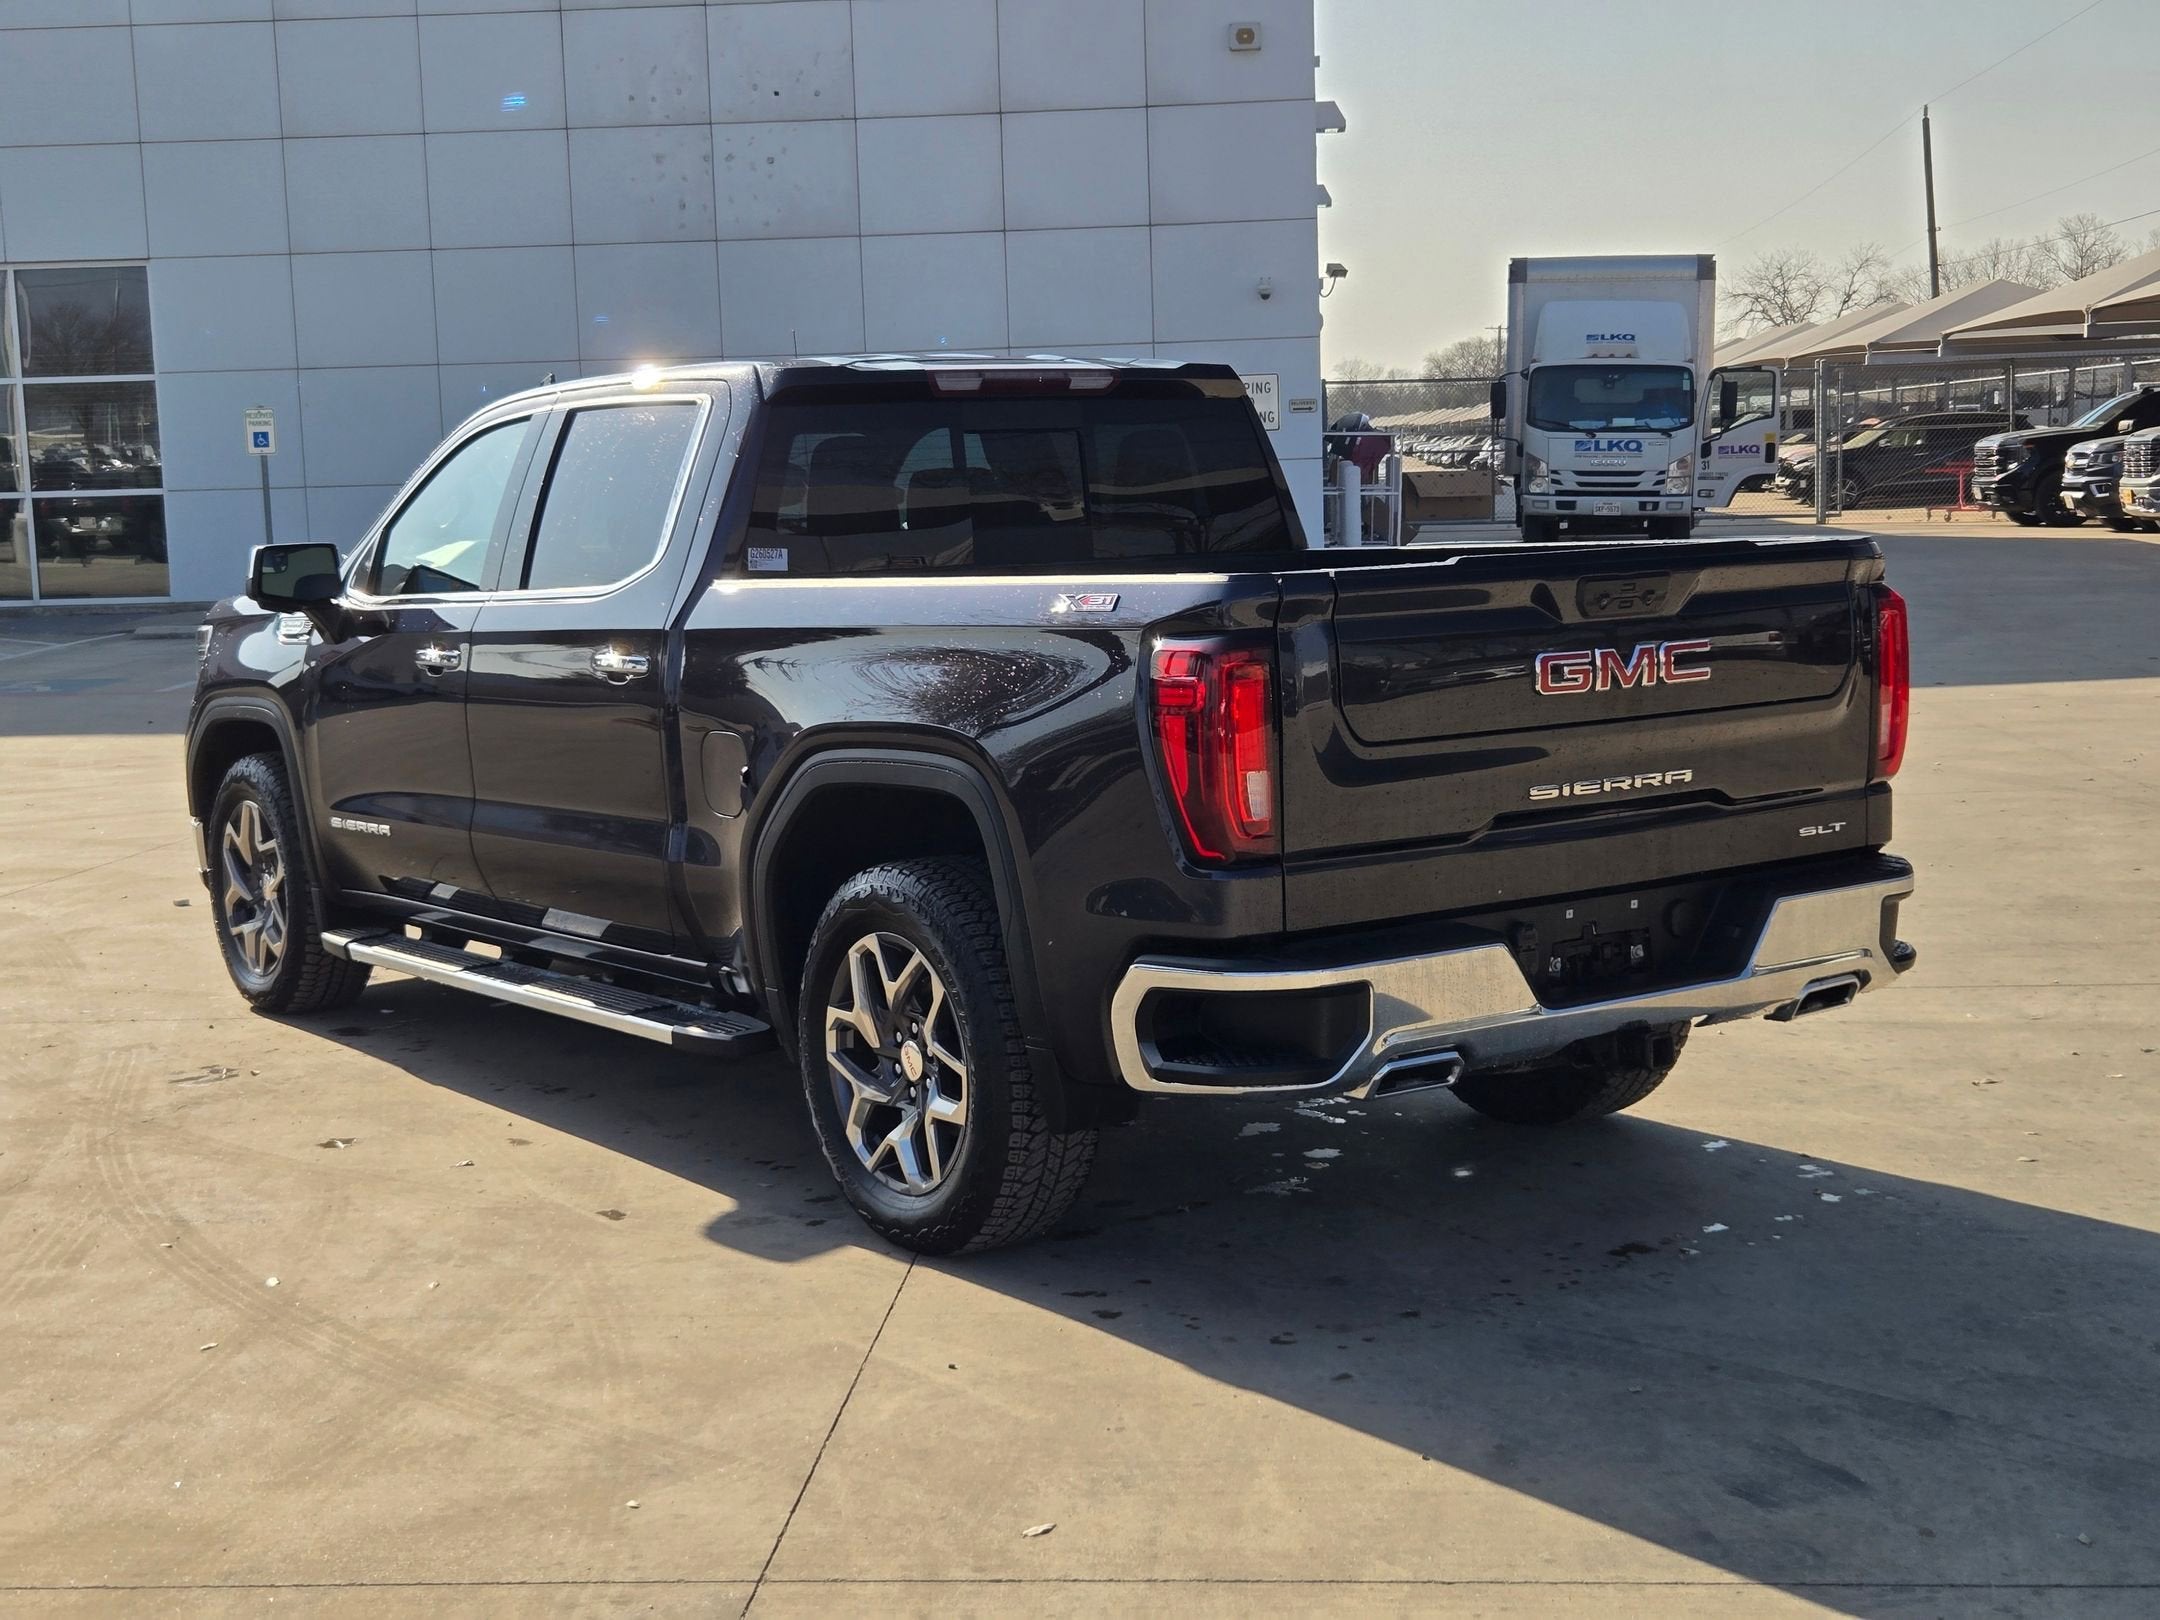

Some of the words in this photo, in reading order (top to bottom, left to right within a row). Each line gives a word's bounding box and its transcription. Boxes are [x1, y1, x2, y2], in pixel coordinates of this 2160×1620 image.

[1594, 440, 1643, 452] LKQ
[1731, 445, 1760, 454] LKQ
[1701, 461, 1710, 470] 31
[751, 548, 783, 559] G260527A
[1058, 593, 1120, 612] X31
[1535, 637, 1711, 695] GMC
[1529, 769, 1692, 800] SIERRA
[330, 816, 391, 837] SIERRA
[1799, 822, 1847, 837] SLT
[904, 1044, 917, 1078] GMC
